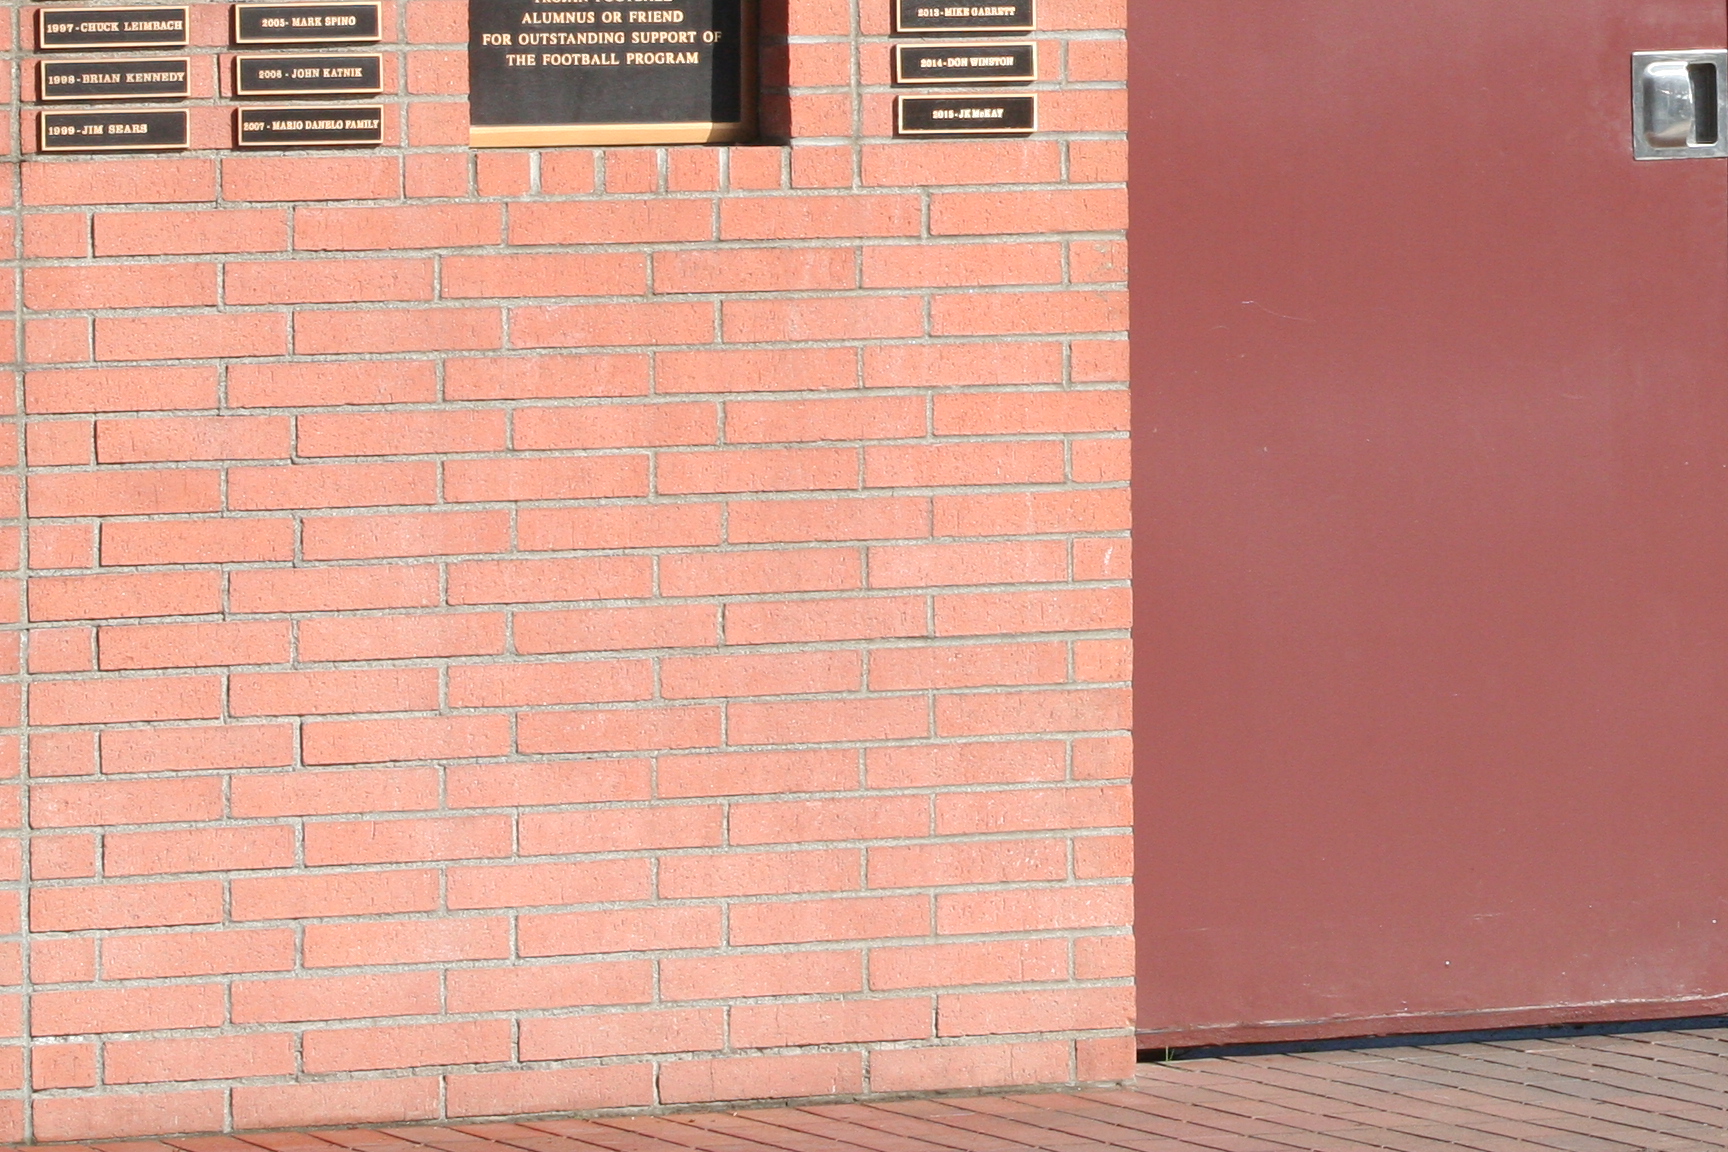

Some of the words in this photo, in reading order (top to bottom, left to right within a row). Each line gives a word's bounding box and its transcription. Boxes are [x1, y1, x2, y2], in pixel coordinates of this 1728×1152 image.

[292, 17, 322, 26] MARK
[325, 16, 356, 26] SPINO
[522, 12, 594, 24] ALUMNUS
[602, 12, 622, 23] OR
[630, 11, 683, 22] FRIEND
[47, 22, 119, 33] 1997-CHUCK
[124, 21, 182, 31] LEIMBACH
[483, 34, 511, 45] FOR
[519, 32, 624, 45] OUTSTANDING
[632, 31, 696, 43] SUPPORT
[703, 30, 722, 43] OF
[506, 54, 535, 66] THE
[543, 53, 619, 65] FOOTBALL
[627, 52, 698, 64] PROGRAM
[49, 74, 120, 84] 1998-BRIAN
[126, 72, 184, 82] KENNEDY
[292, 69, 319, 78] JOHN
[323, 68, 362, 77] KATNIK
[49, 125, 103, 135] 1999-JIM
[108, 124, 147, 134] SEARS
[272, 121, 303, 130] MARIO
[305, 120, 343, 129] DANELO
[345, 120, 379, 129] FAMILY
